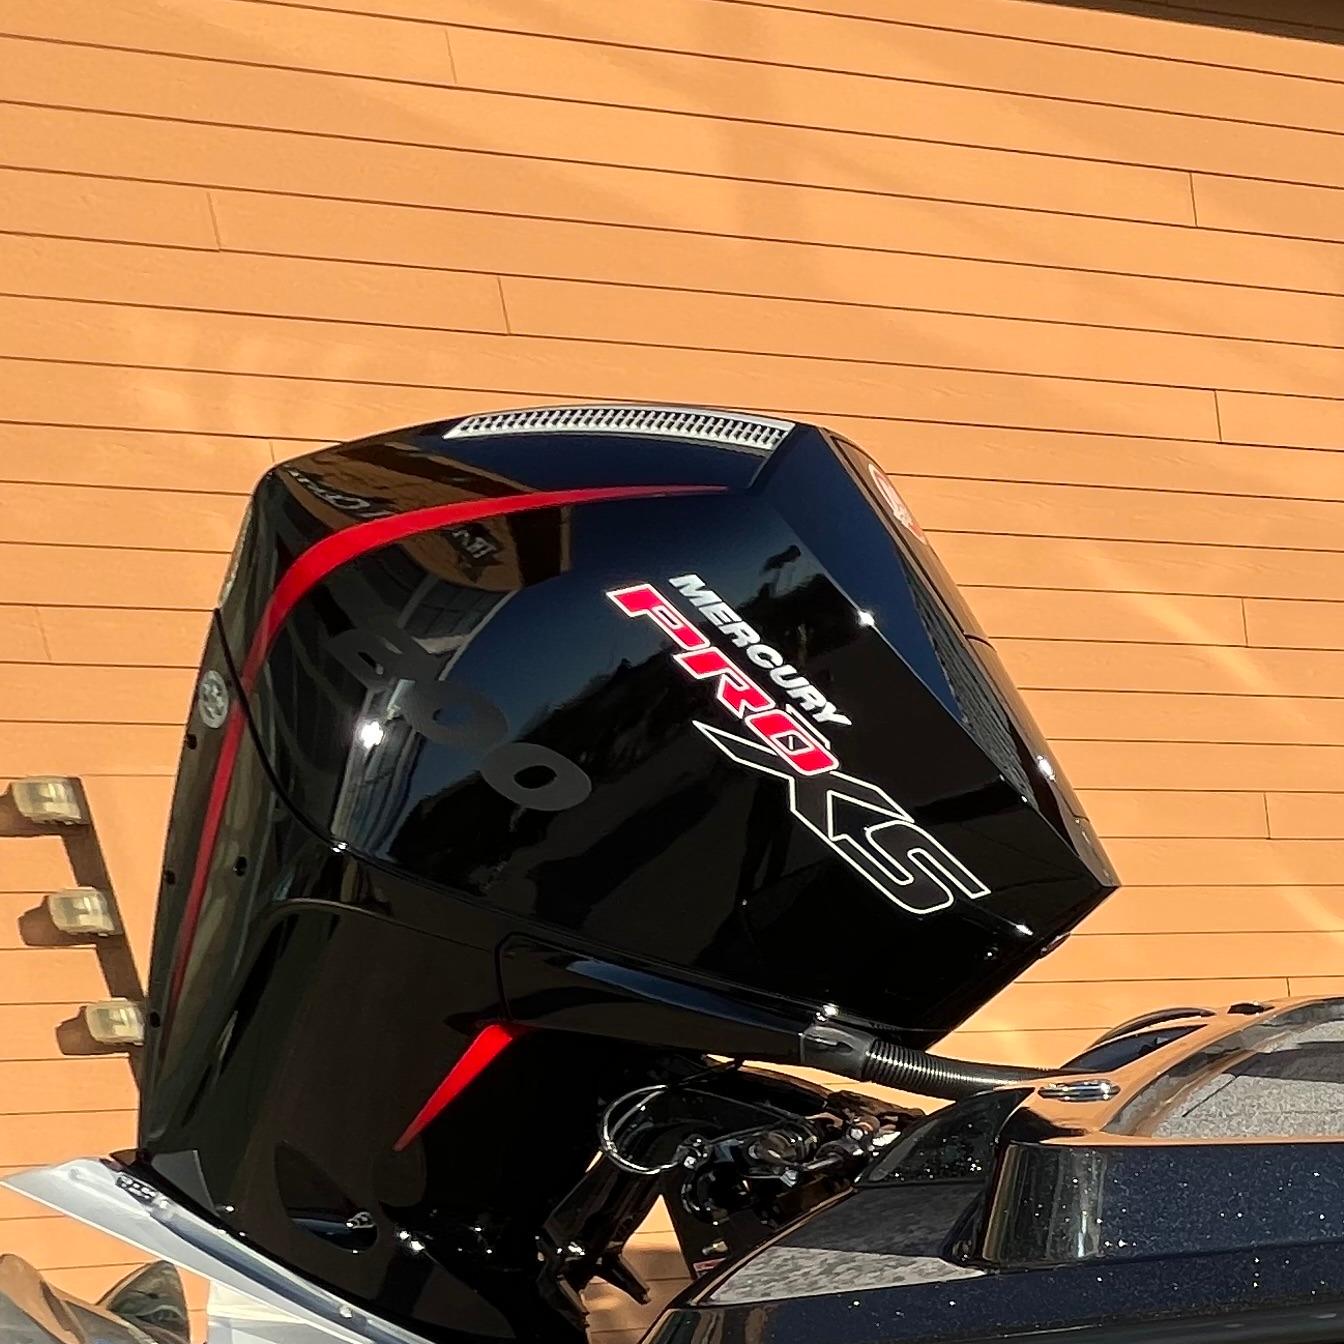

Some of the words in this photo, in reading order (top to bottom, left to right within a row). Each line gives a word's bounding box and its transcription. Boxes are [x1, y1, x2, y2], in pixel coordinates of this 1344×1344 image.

[606, 582, 840, 777] PRO
[668, 572, 853, 727] MERCURY
[691, 703, 992, 915] XS
